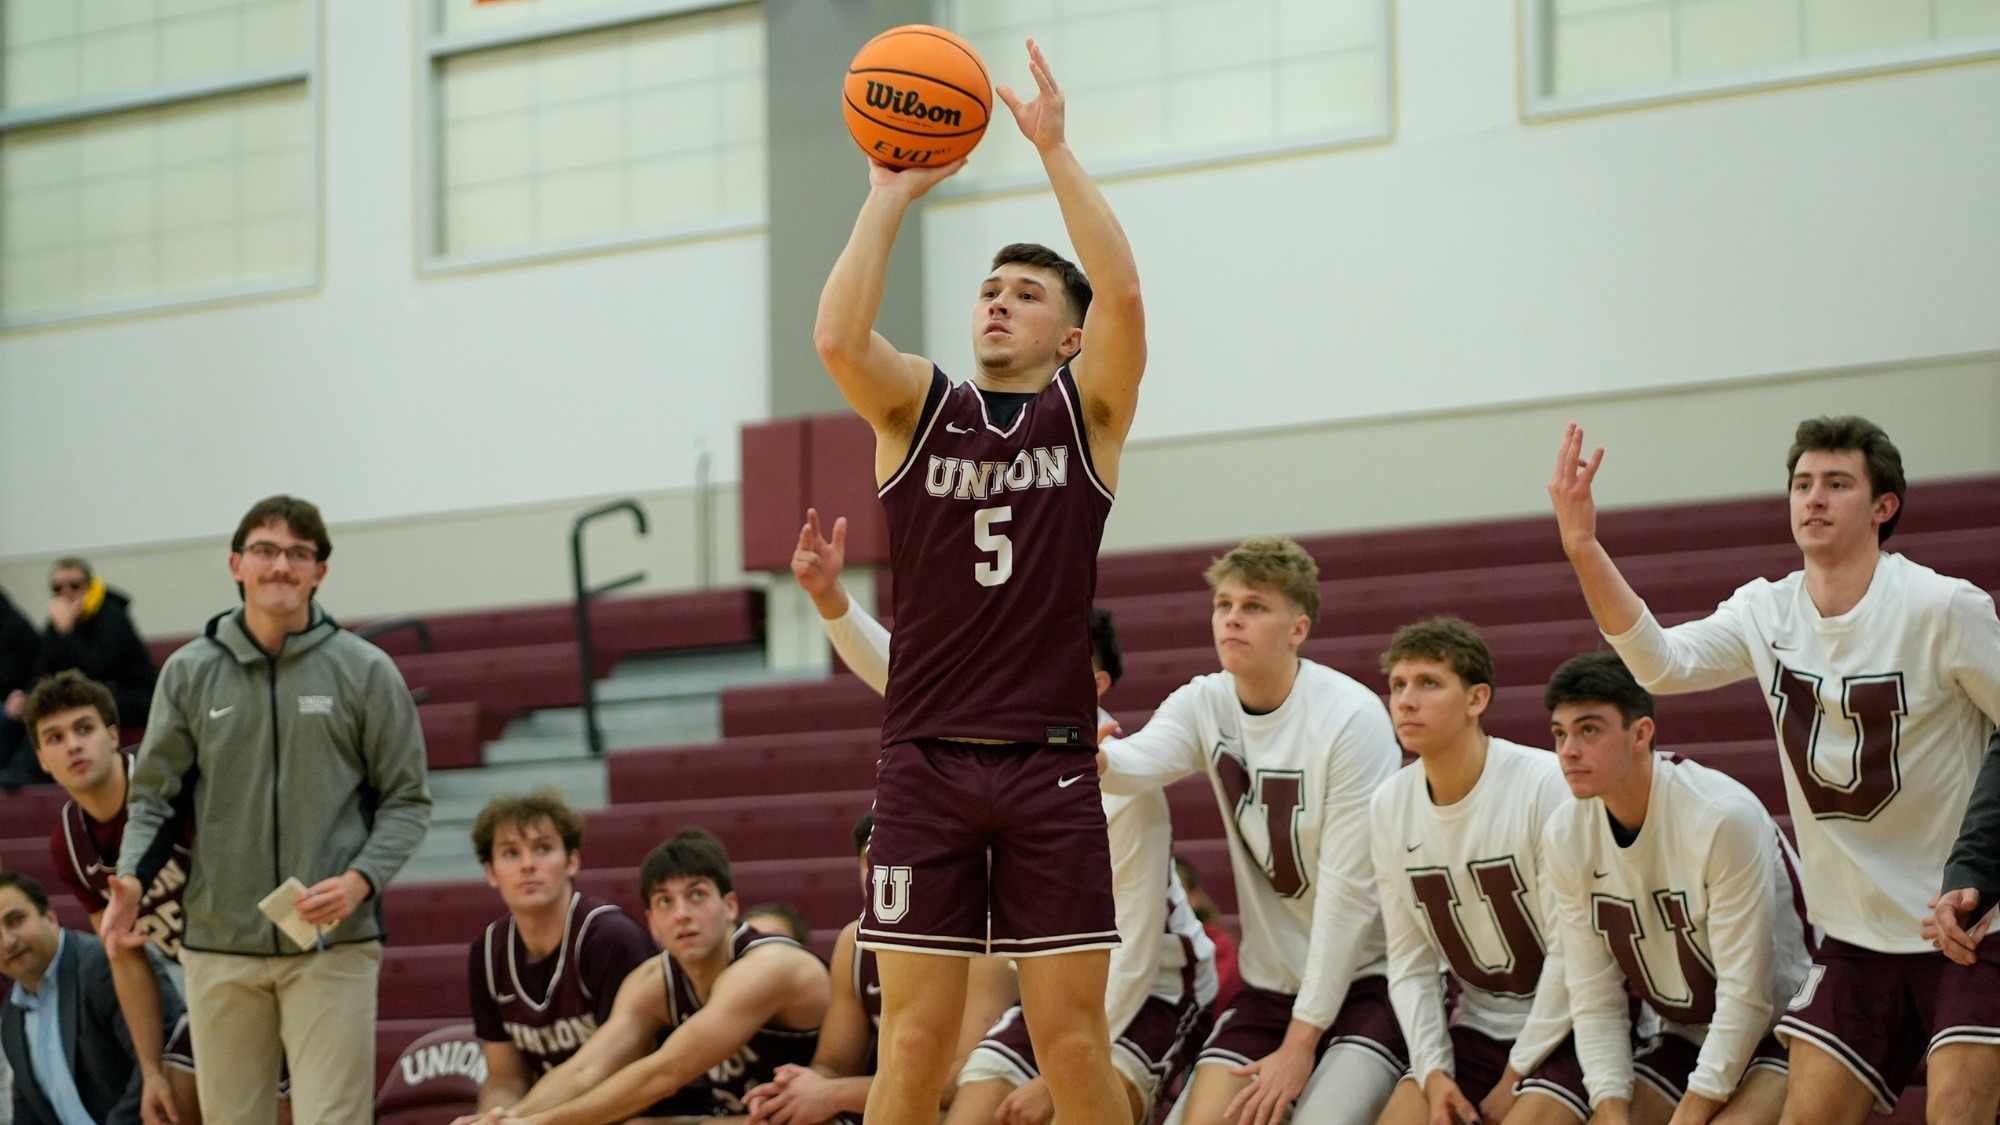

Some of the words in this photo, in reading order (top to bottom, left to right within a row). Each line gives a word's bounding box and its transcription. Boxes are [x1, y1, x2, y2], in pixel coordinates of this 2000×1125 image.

[865, 80, 962, 127] Wilson
[873, 140, 933, 163] EVO
[925, 445, 1068, 500] UNION
[974, 505, 1013, 588] 5
[1071, 731, 1078, 740] M
[1770, 659, 1909, 822] U
[872, 864, 913, 924] U
[1405, 854, 1549, 1000] U
[1591, 888, 1718, 1025] U
